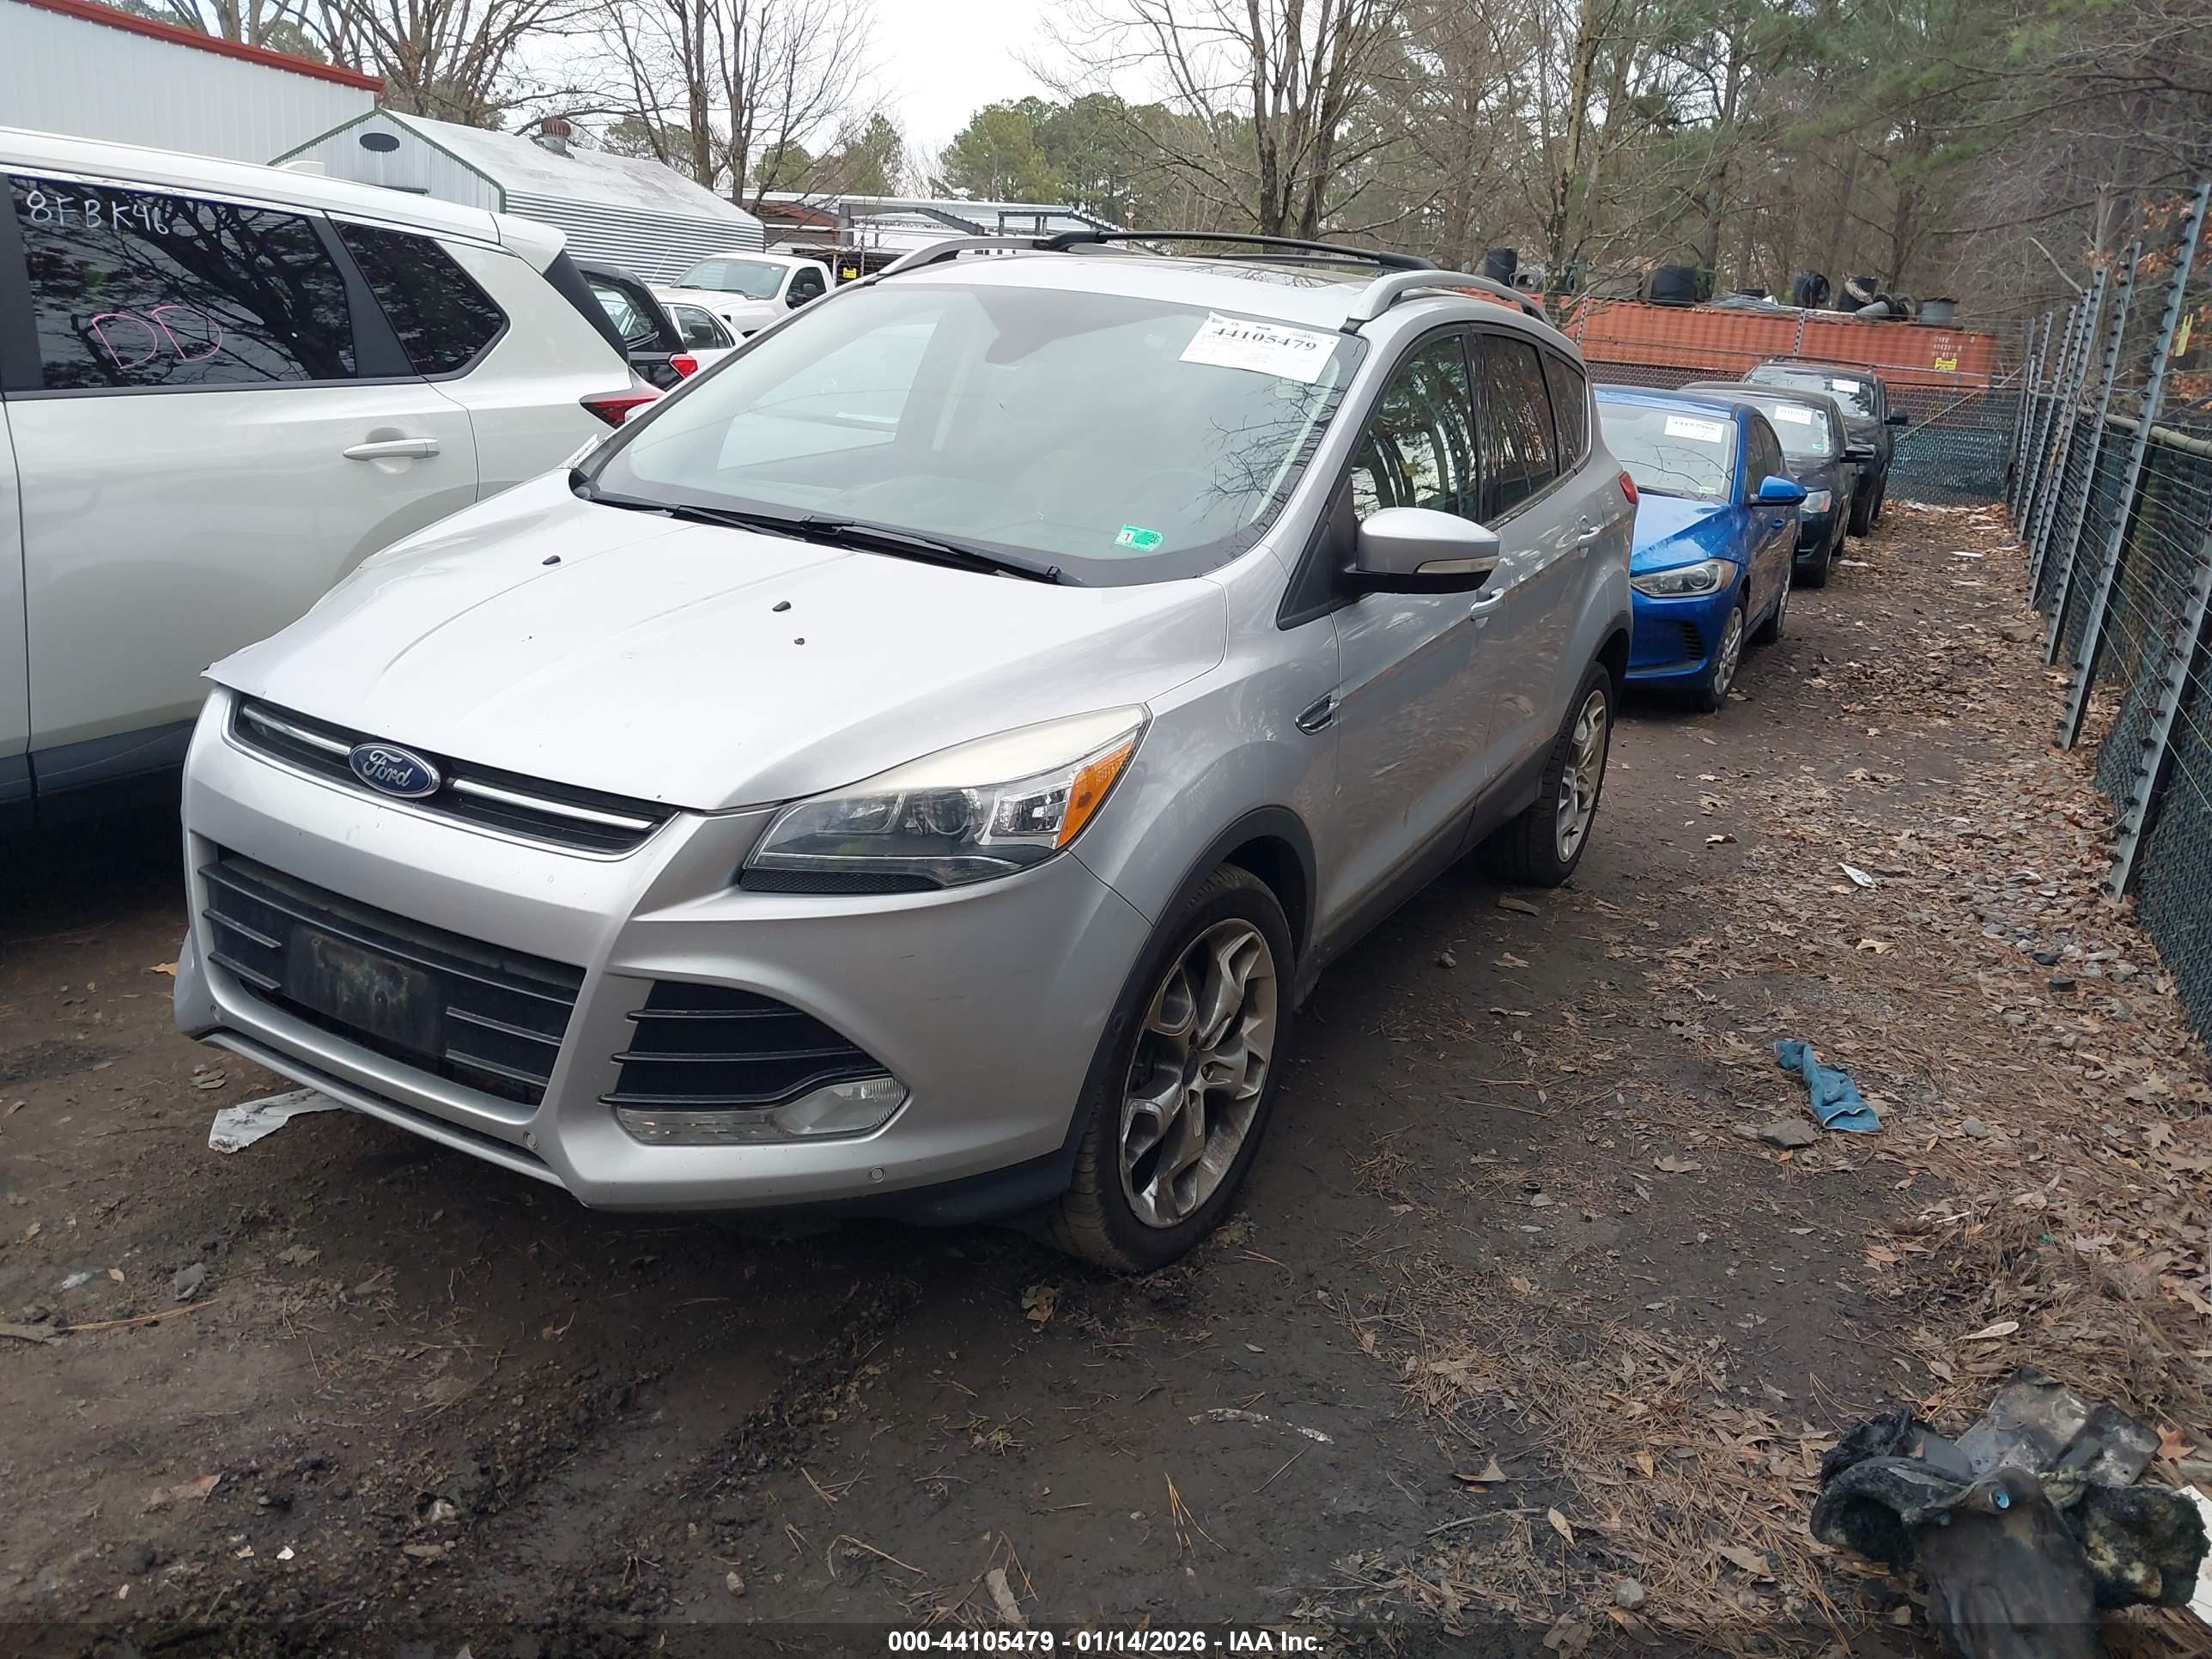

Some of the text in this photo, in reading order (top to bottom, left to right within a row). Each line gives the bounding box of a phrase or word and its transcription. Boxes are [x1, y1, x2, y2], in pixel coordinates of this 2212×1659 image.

[27, 190, 169, 234] 8FBK46
[1213, 327, 1317, 351] 44105479
[362, 750, 414, 787] Ford
